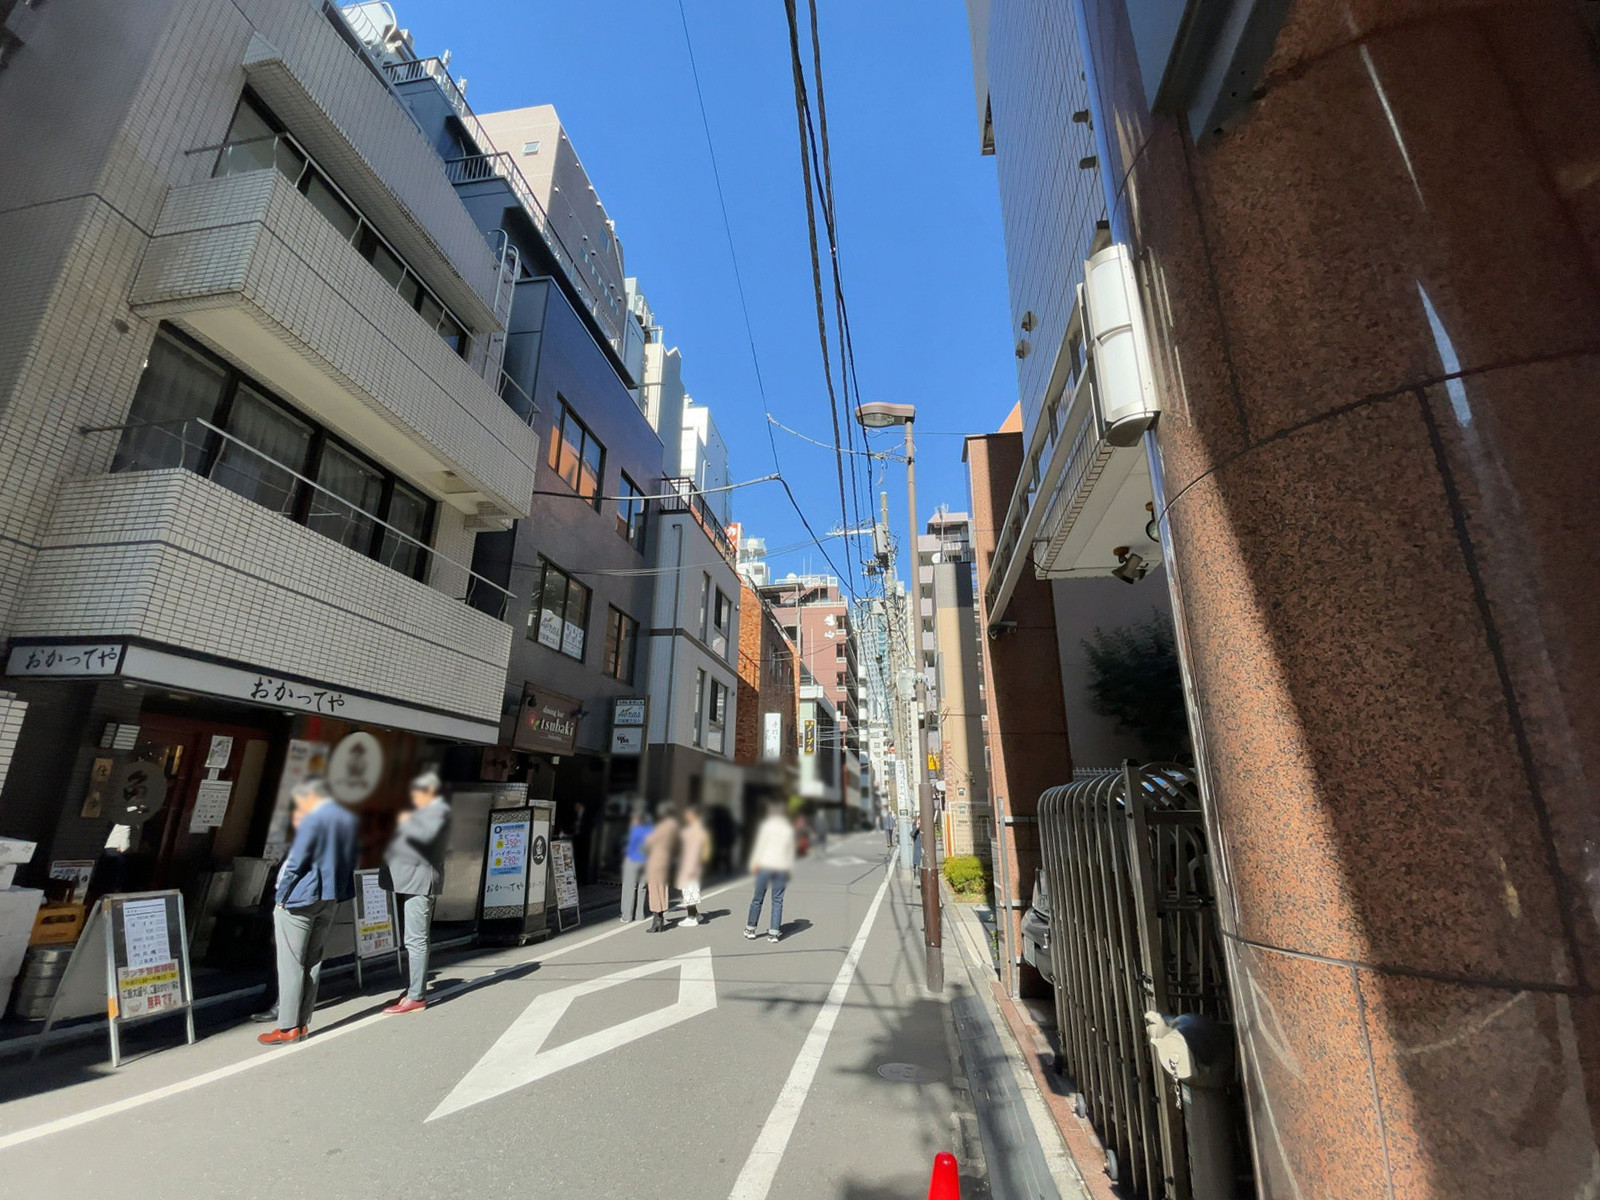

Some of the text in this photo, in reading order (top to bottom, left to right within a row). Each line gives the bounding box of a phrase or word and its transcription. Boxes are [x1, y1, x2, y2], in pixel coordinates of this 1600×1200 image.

[25, 648, 118, 669] おかってや
[250, 677, 346, 712] おかってや
[486, 883, 524, 892] おかってや
